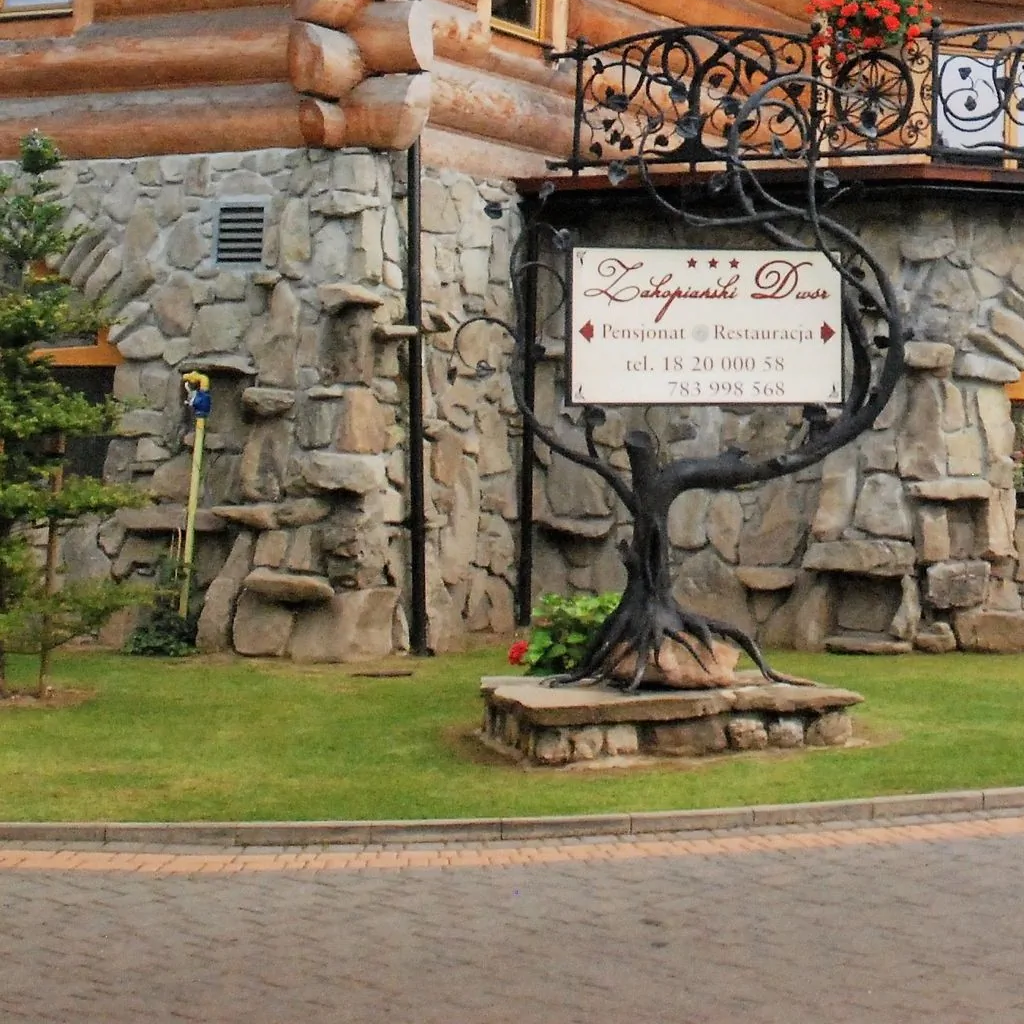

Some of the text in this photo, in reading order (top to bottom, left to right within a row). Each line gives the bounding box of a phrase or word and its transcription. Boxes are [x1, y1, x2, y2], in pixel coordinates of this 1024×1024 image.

[602, 323, 686, 343] Pensjonat
[714, 324, 813, 344] Restauracja
[626, 355, 785, 372] tel. 18 20 000 58
[667, 380, 786, 397] 783 998 568
